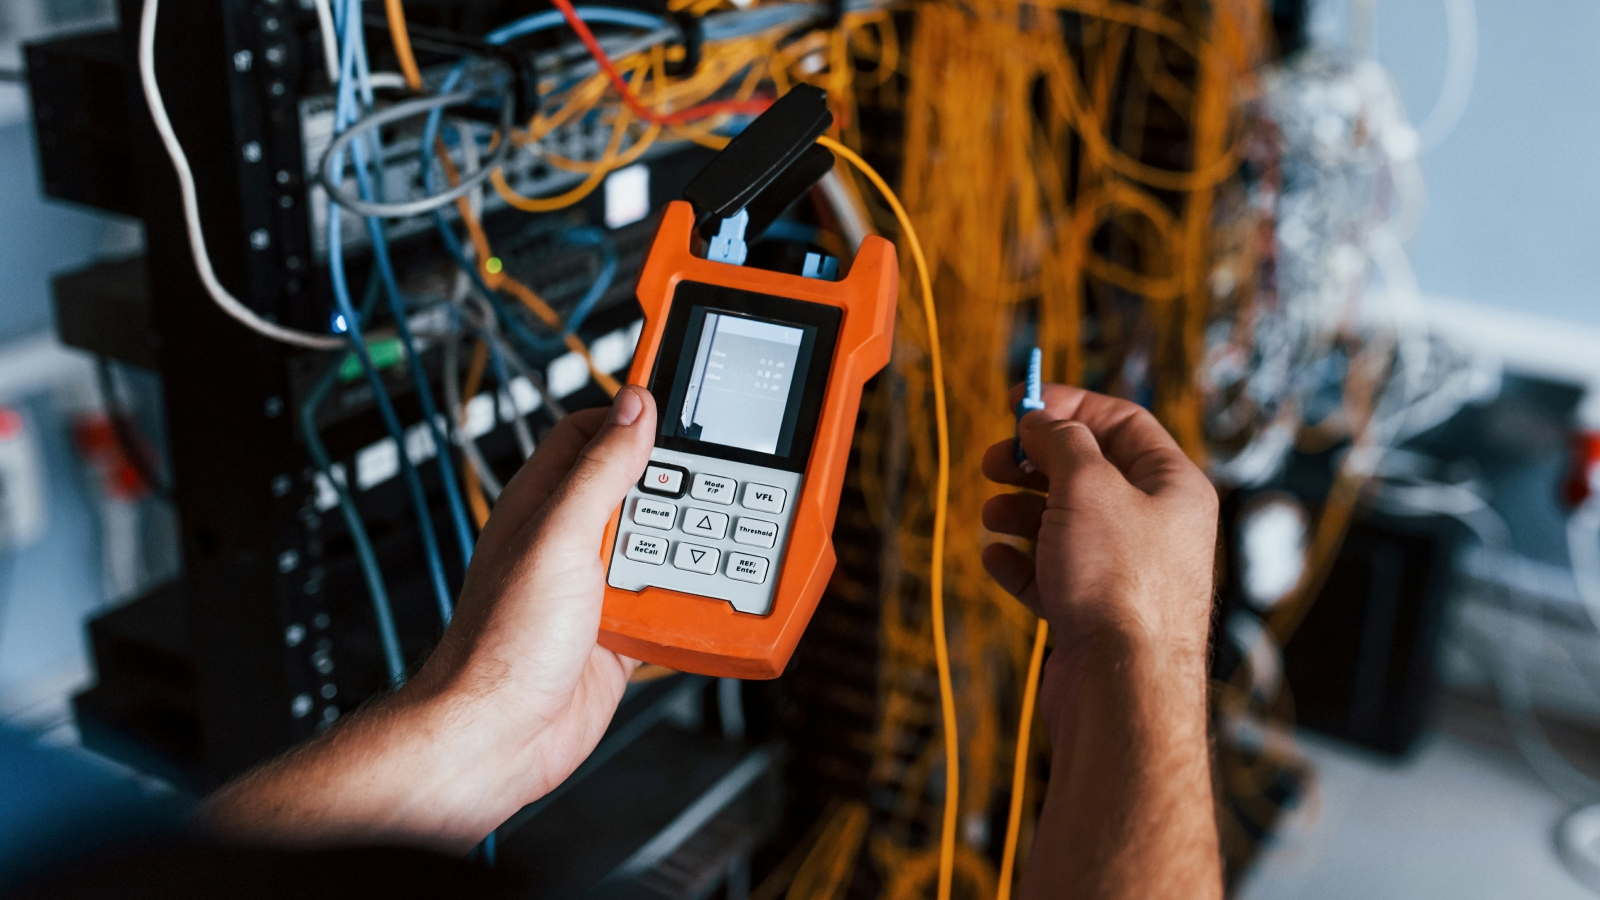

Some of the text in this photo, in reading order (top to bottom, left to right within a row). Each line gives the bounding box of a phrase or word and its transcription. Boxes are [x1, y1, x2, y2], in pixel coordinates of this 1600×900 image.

[704, 480, 725, 489] Mode
[755, 492, 773, 502] VFL
[641, 507, 670, 517] dBm/dB
[739, 526, 773, 537] Threshold
[639, 540, 656, 548] Save
[634, 546, 658, 556] ReCall
[739, 559, 756, 568] REF/
[736, 566, 757, 575] Enter
